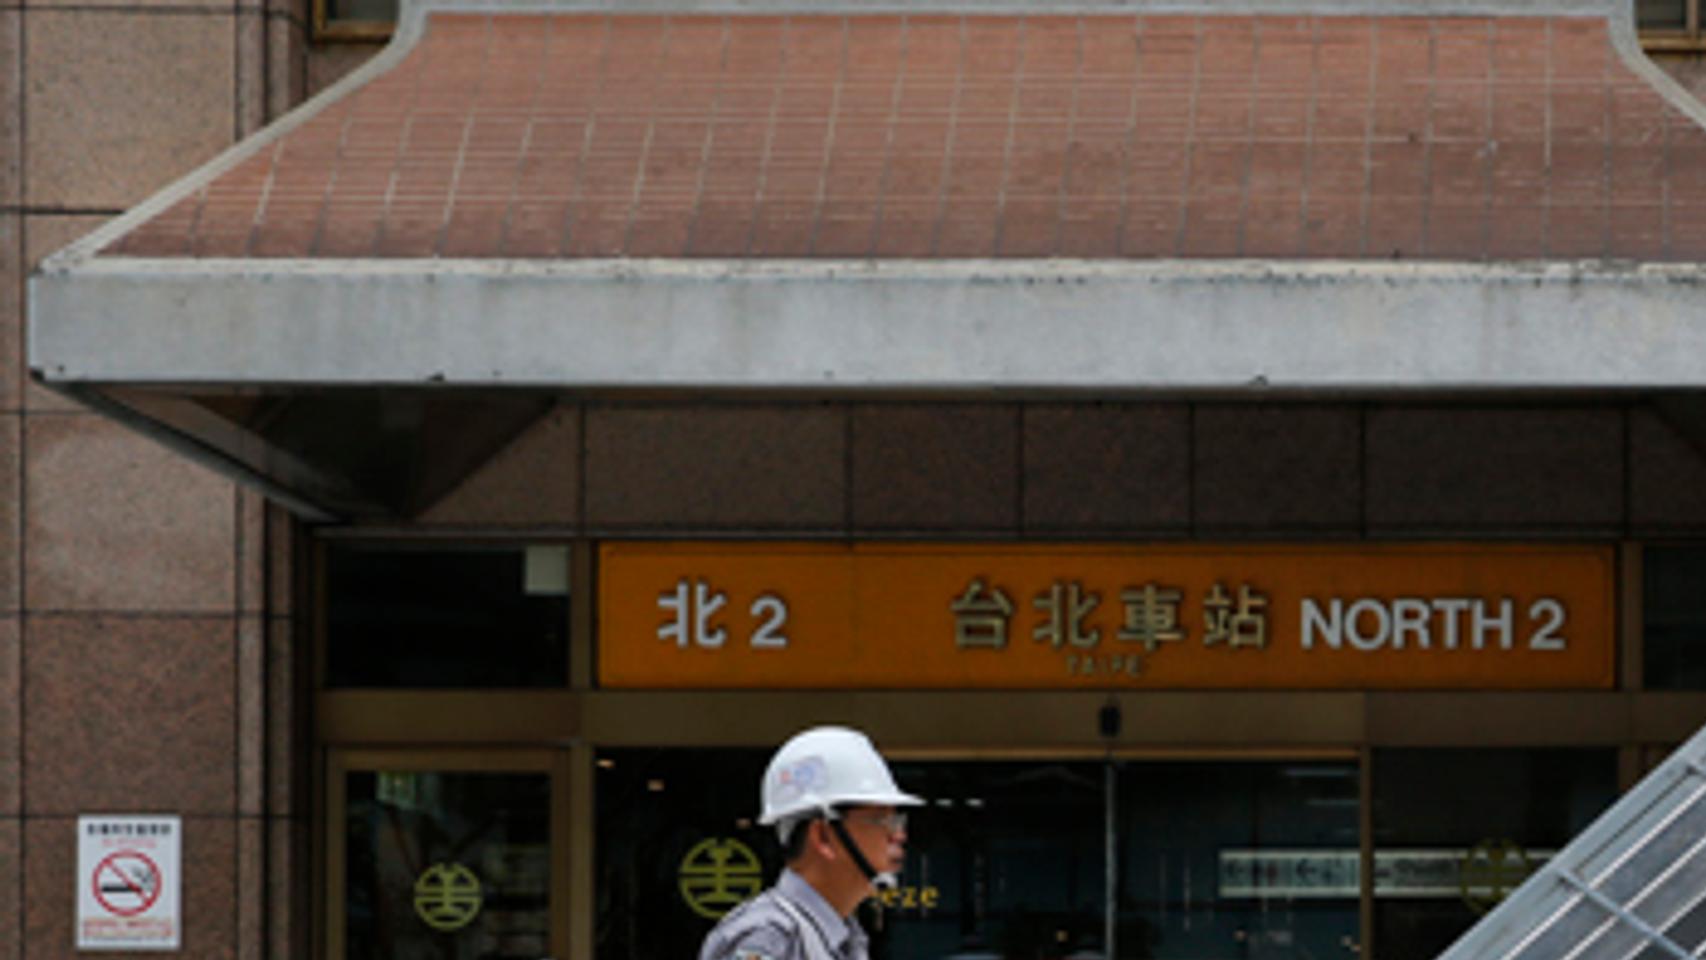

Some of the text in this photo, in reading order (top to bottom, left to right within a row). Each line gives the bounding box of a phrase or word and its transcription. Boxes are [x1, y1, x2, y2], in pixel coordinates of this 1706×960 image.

[656, 581, 788, 649] 北 2
[951, 580, 1566, 651] 台北車站 NORTH 2
